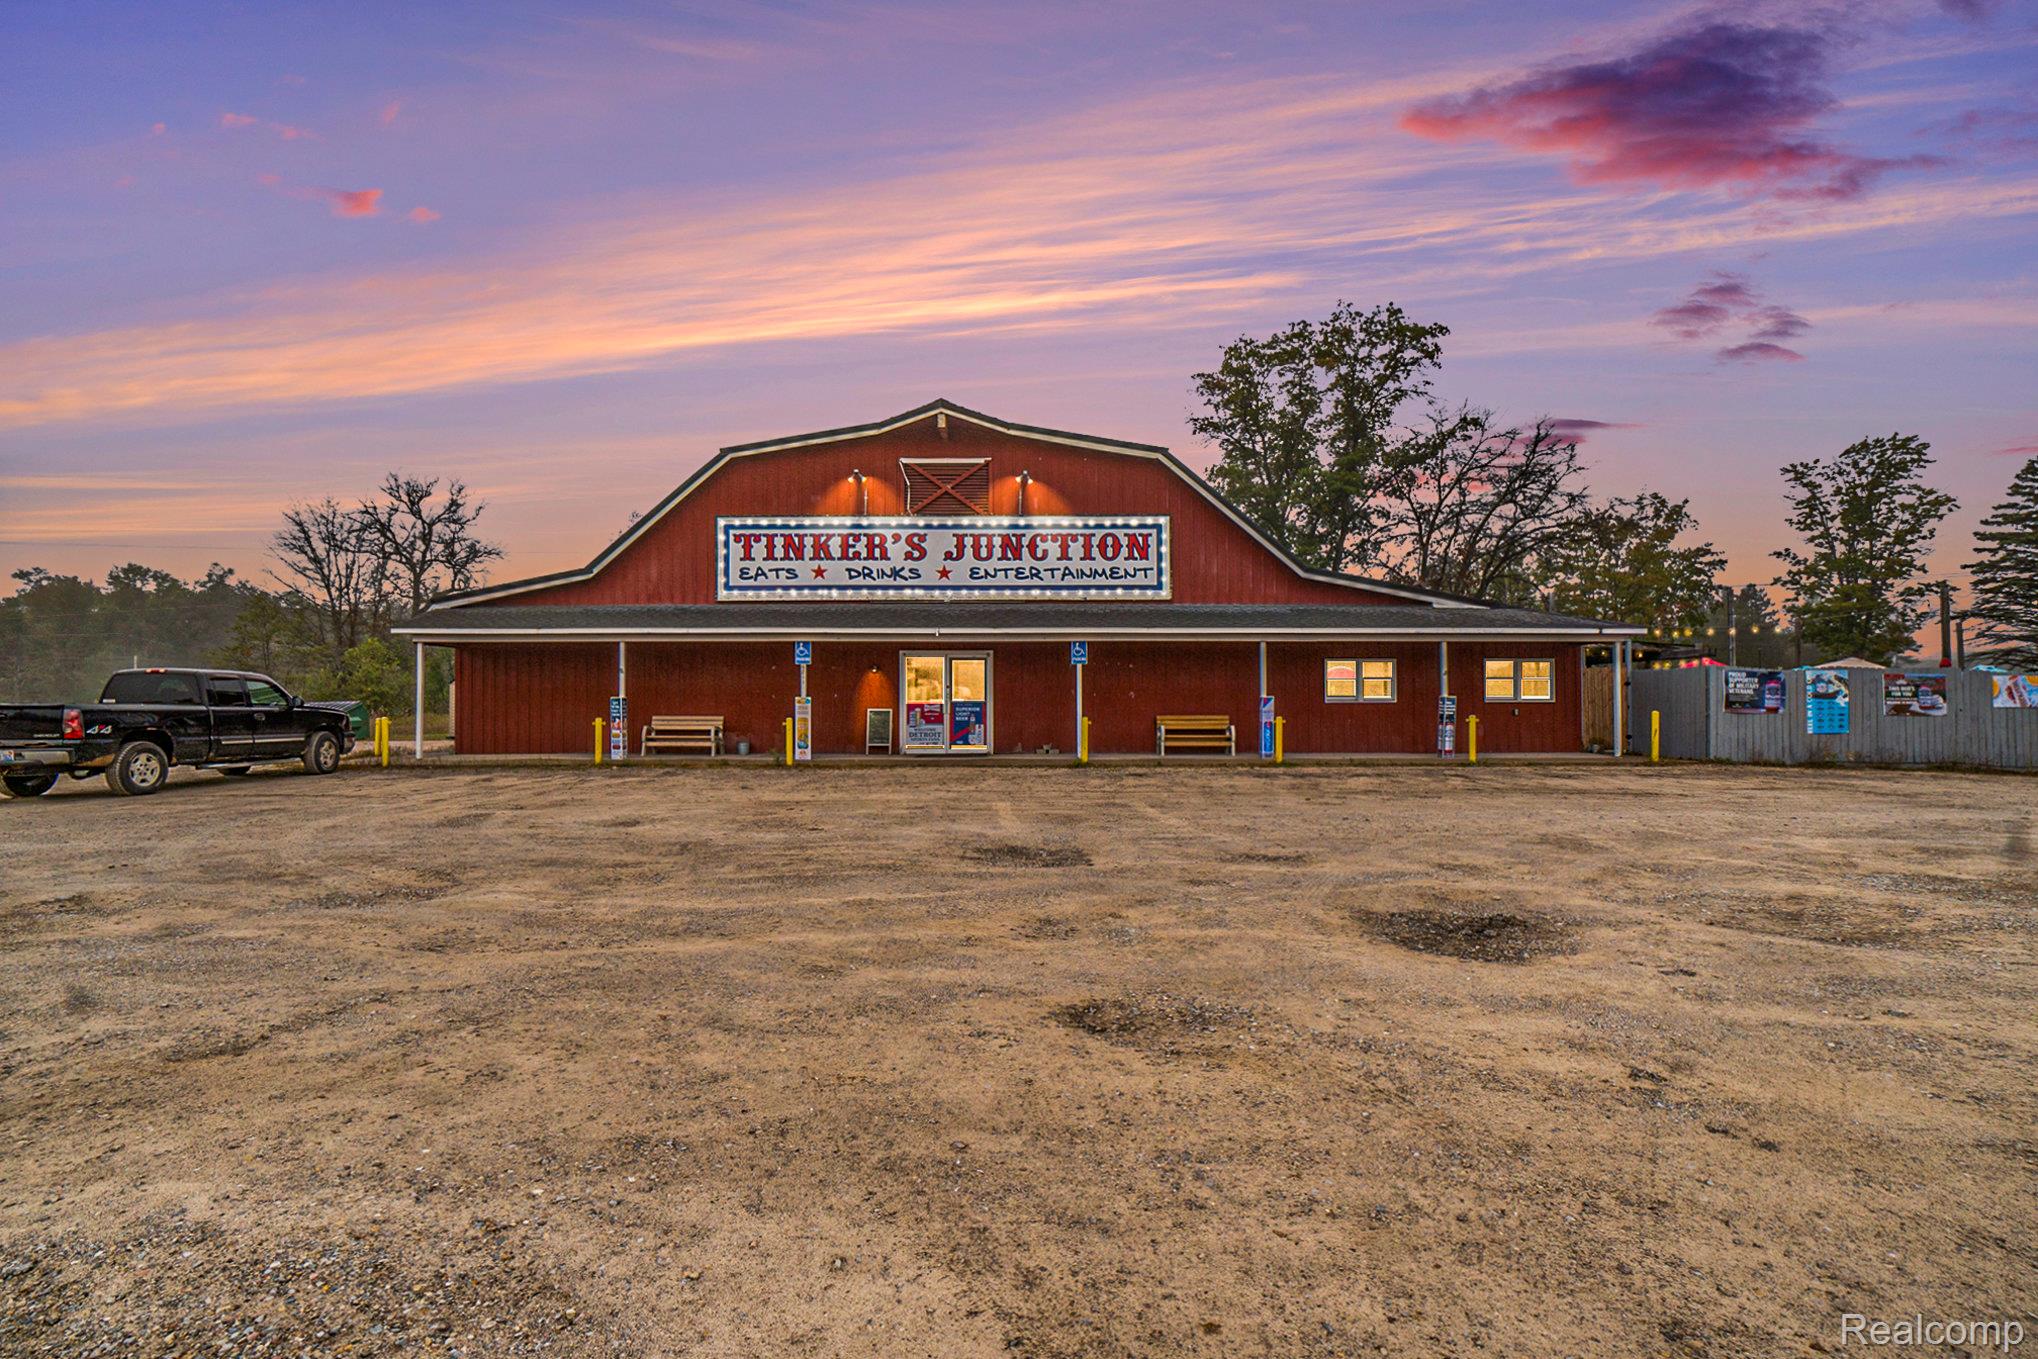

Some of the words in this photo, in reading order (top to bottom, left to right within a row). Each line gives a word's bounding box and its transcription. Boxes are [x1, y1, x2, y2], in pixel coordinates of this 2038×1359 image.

[733, 532, 928, 562] TINKER'S
[943, 532, 1153, 562] JUNCTION
[738, 566, 799, 582] EATS
[845, 565, 922, 582] DRINKS
[969, 566, 1154, 582] ENTERTAINMENT
